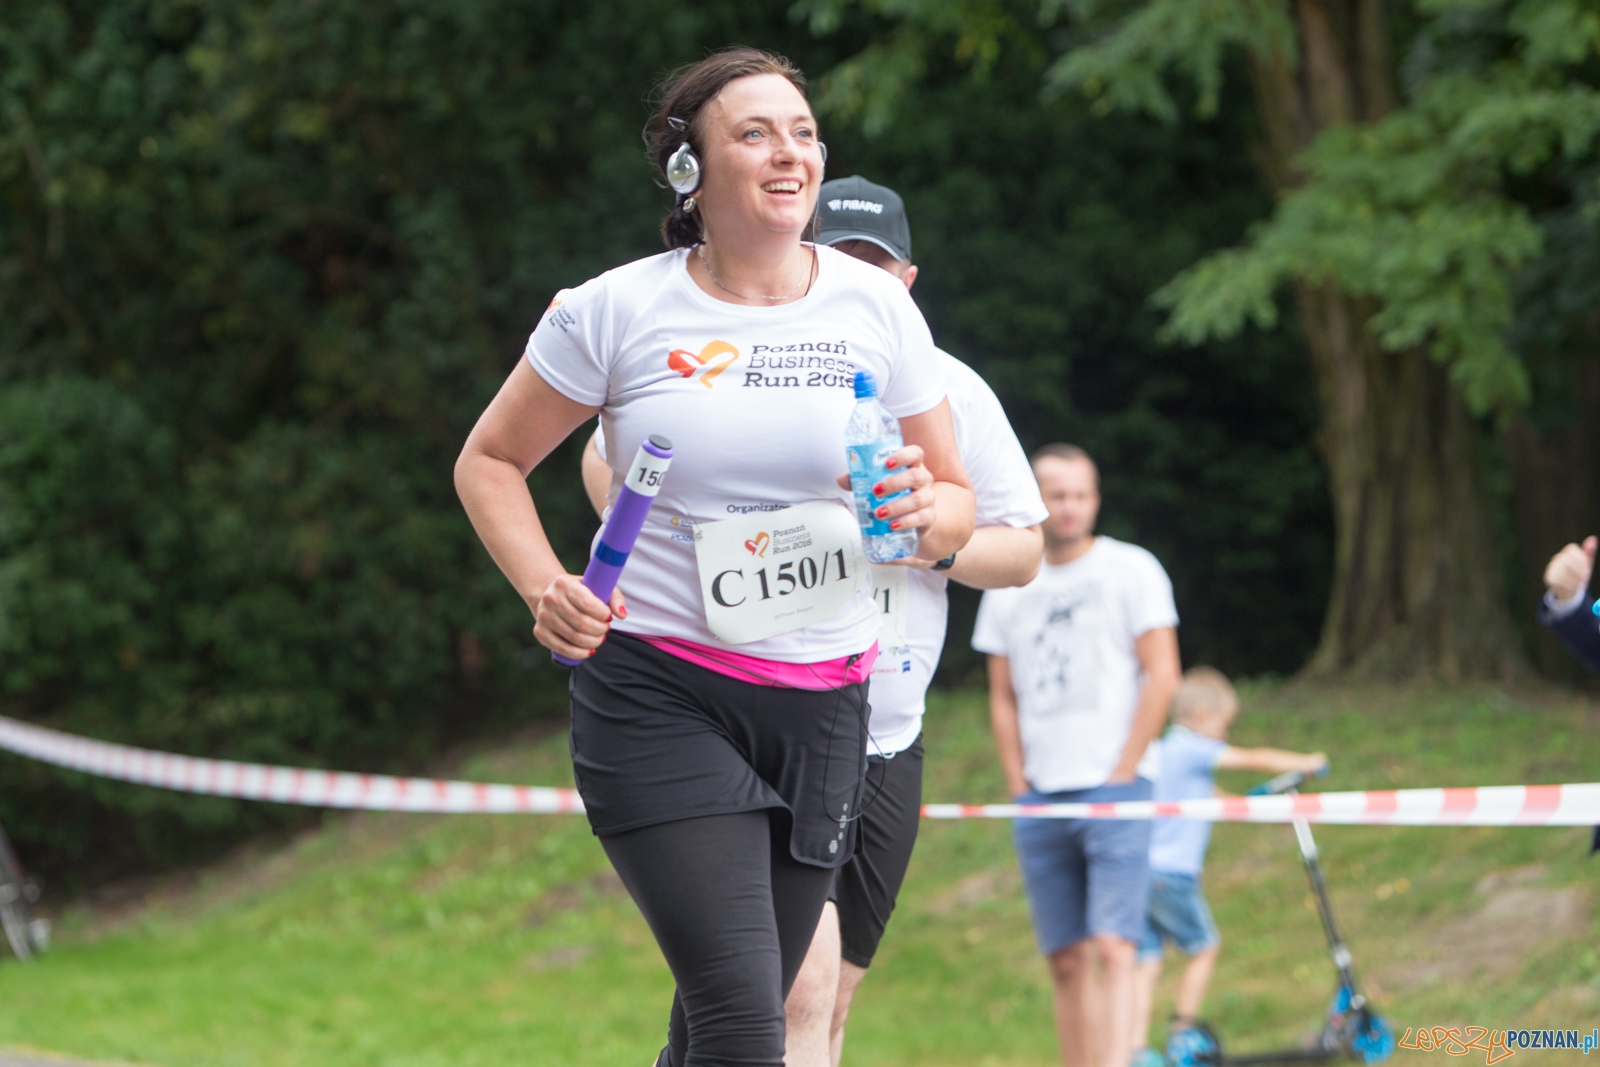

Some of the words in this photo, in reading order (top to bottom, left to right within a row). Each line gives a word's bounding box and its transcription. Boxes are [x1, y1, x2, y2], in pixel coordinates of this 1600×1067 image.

[751, 340, 847, 355] Poznań
[747, 353, 855, 376] Business
[742, 371, 800, 388] Run
